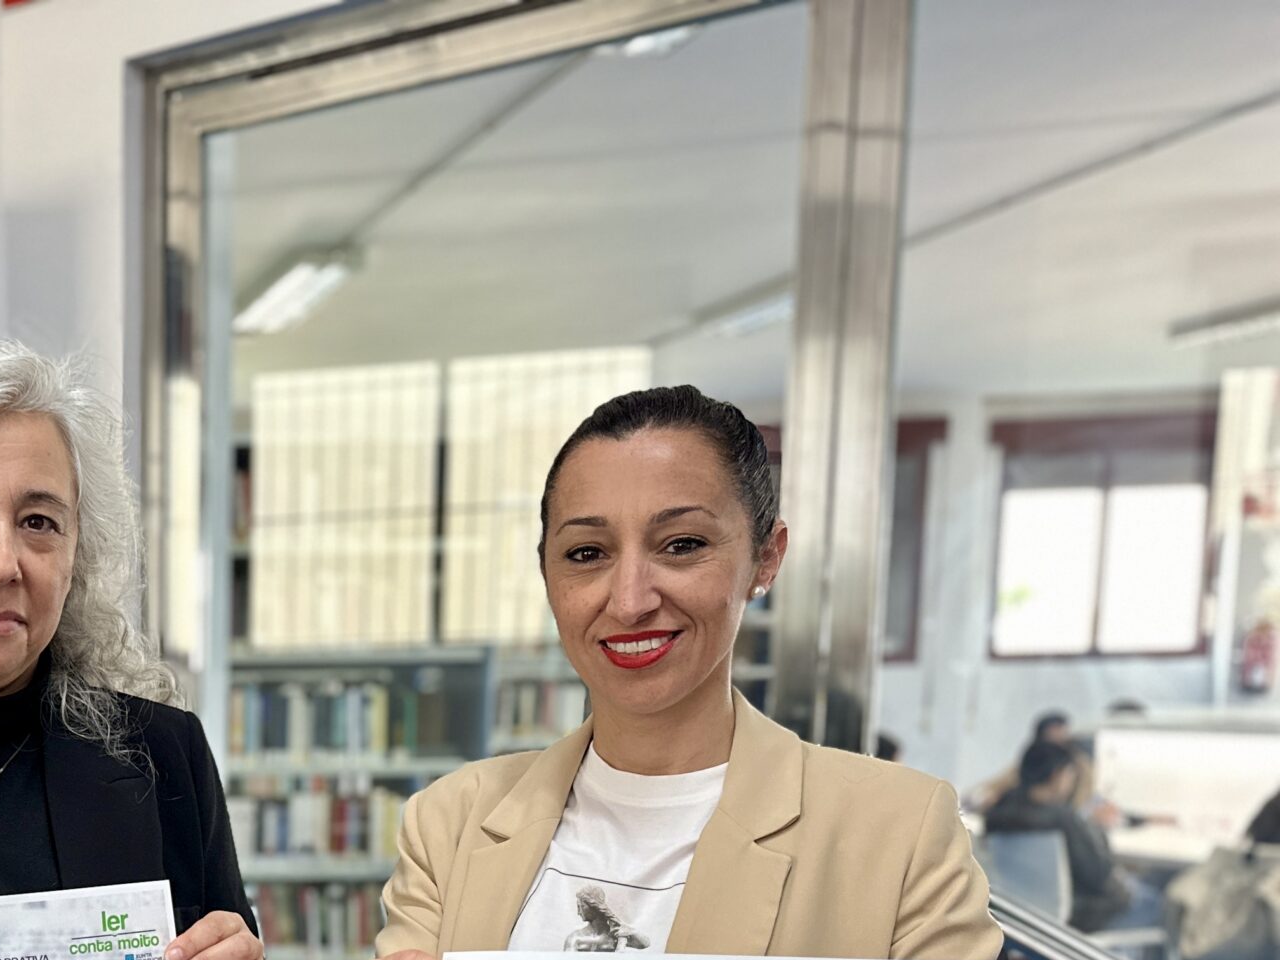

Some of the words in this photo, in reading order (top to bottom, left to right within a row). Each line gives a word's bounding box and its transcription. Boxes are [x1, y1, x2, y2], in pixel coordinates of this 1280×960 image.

[101, 910, 128, 932] ler
[69, 939, 113, 955] conta
[117, 934, 159, 950] moito
